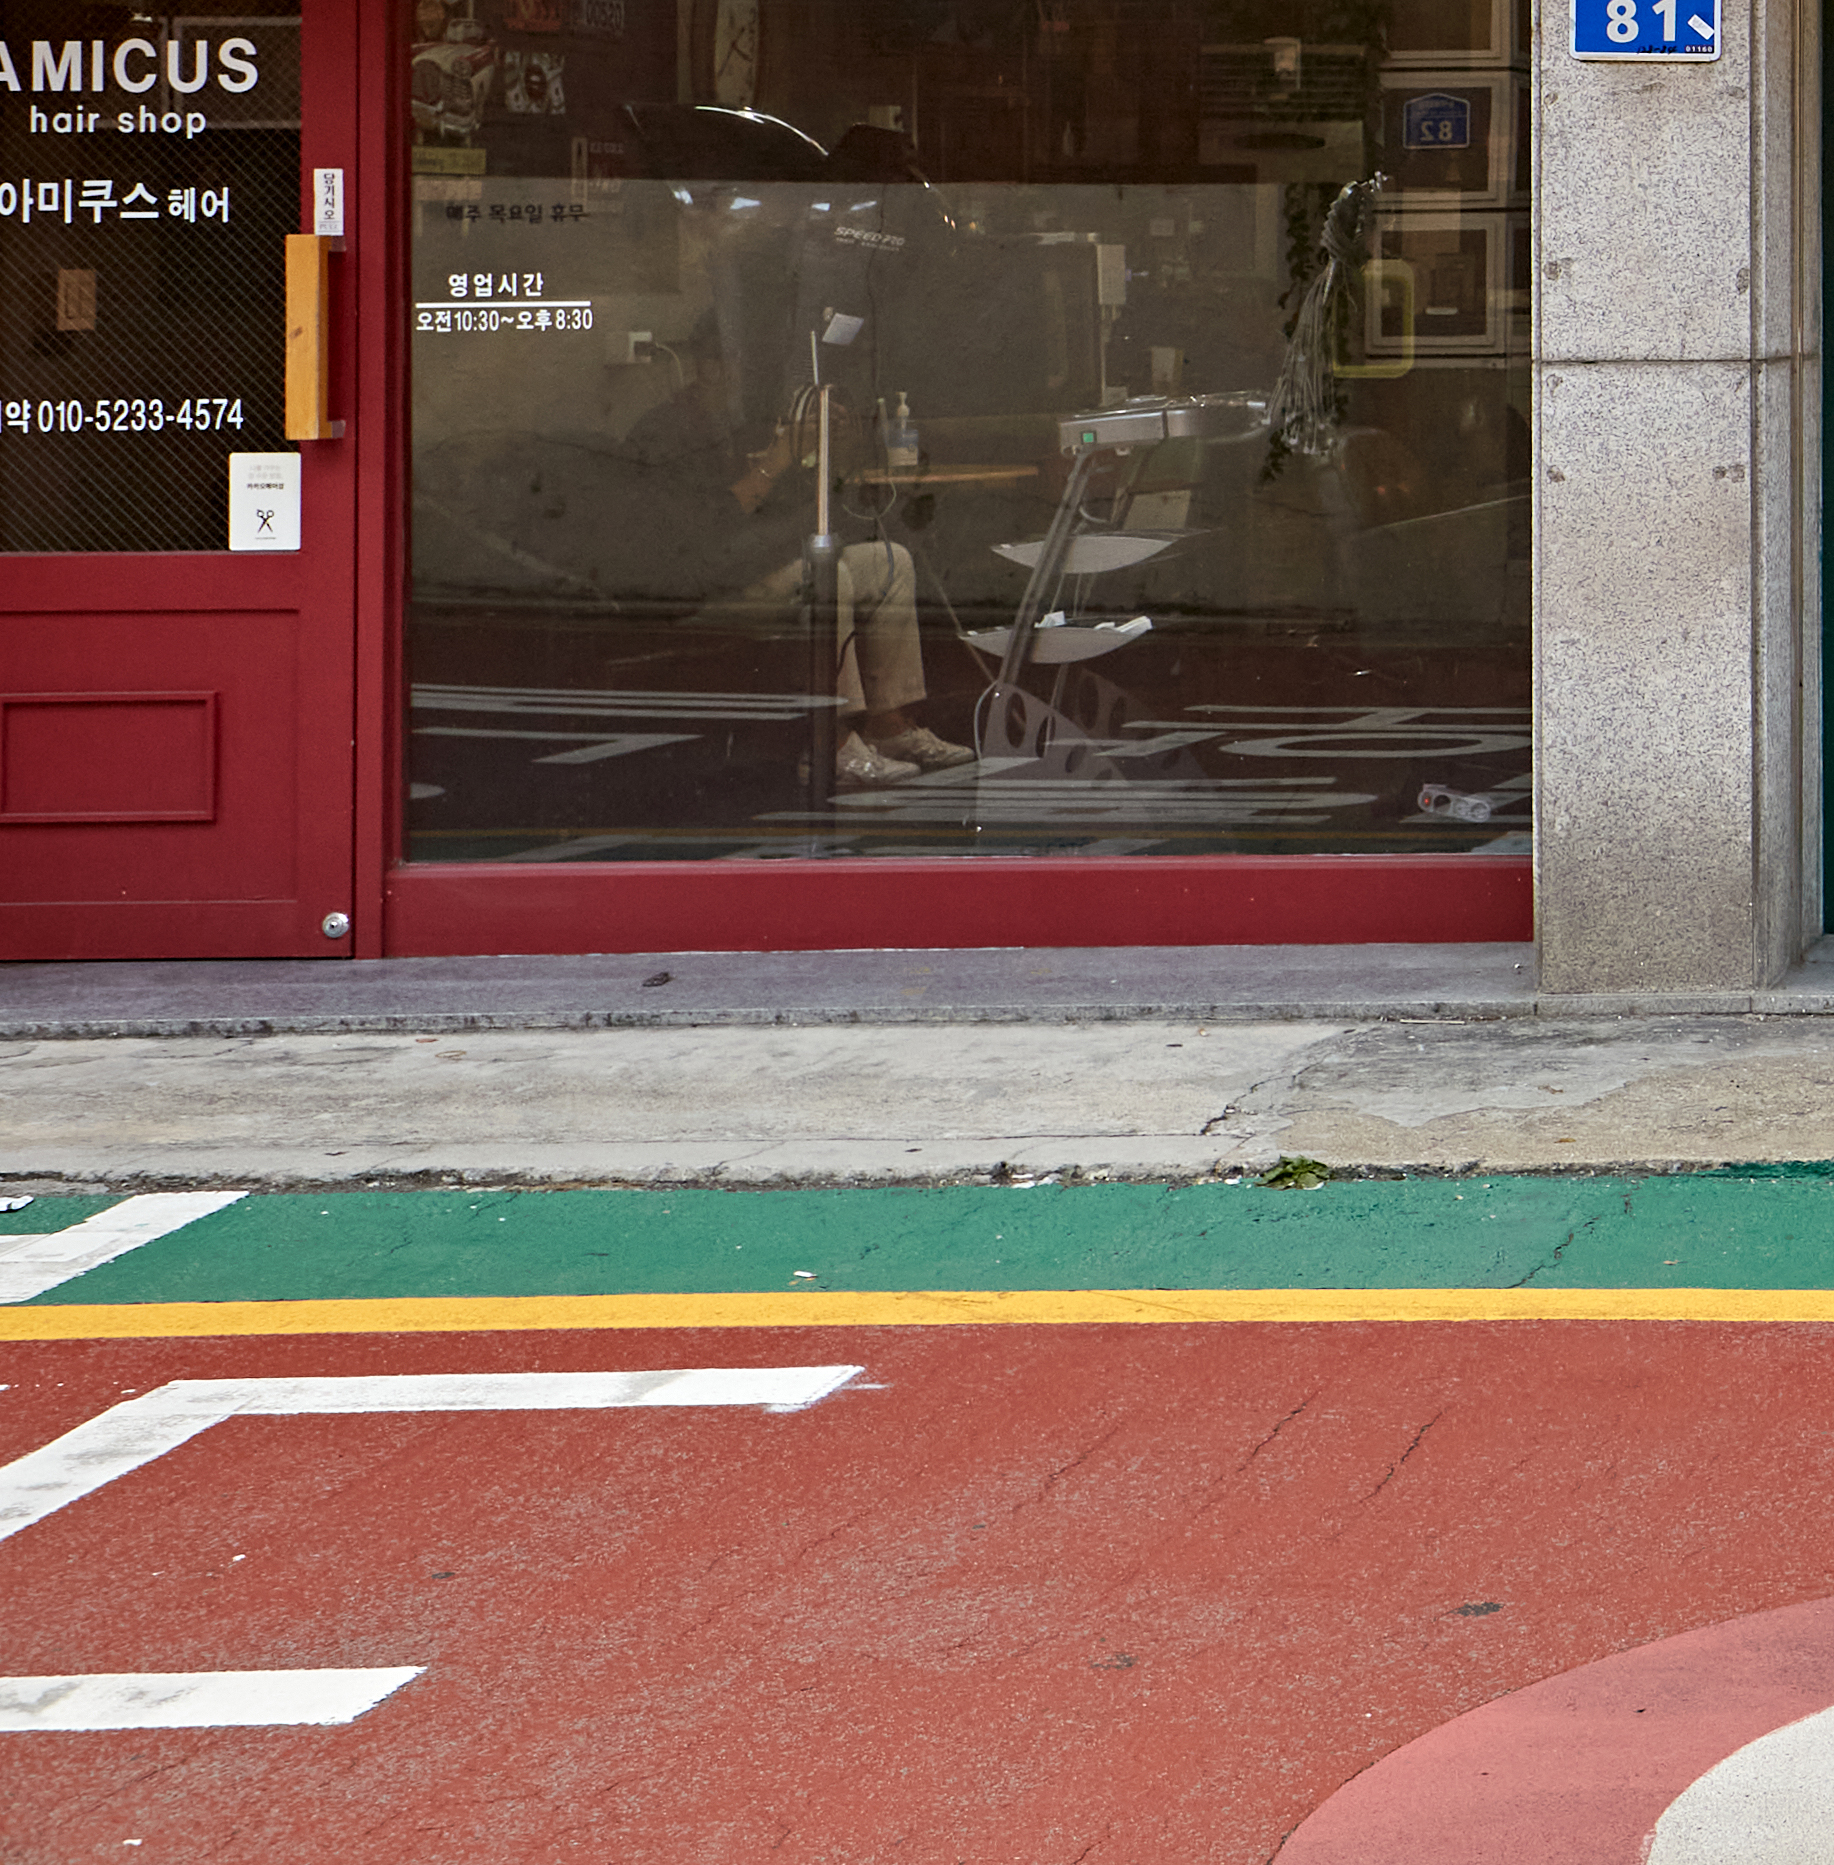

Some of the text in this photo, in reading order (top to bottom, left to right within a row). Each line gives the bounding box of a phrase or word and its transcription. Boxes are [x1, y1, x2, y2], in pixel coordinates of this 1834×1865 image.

[30, 105, 207, 140] hair shop
[0, 178, 230, 224] 아미쿠스 헤어
[323, 173, 335, 220] 당기시오
[489, 203, 543, 224] 목요일
[551, 202, 592, 223] 휴무
[448, 272, 544, 298] 영업시간
[37, 398, 244, 432] 010-5233-4574
